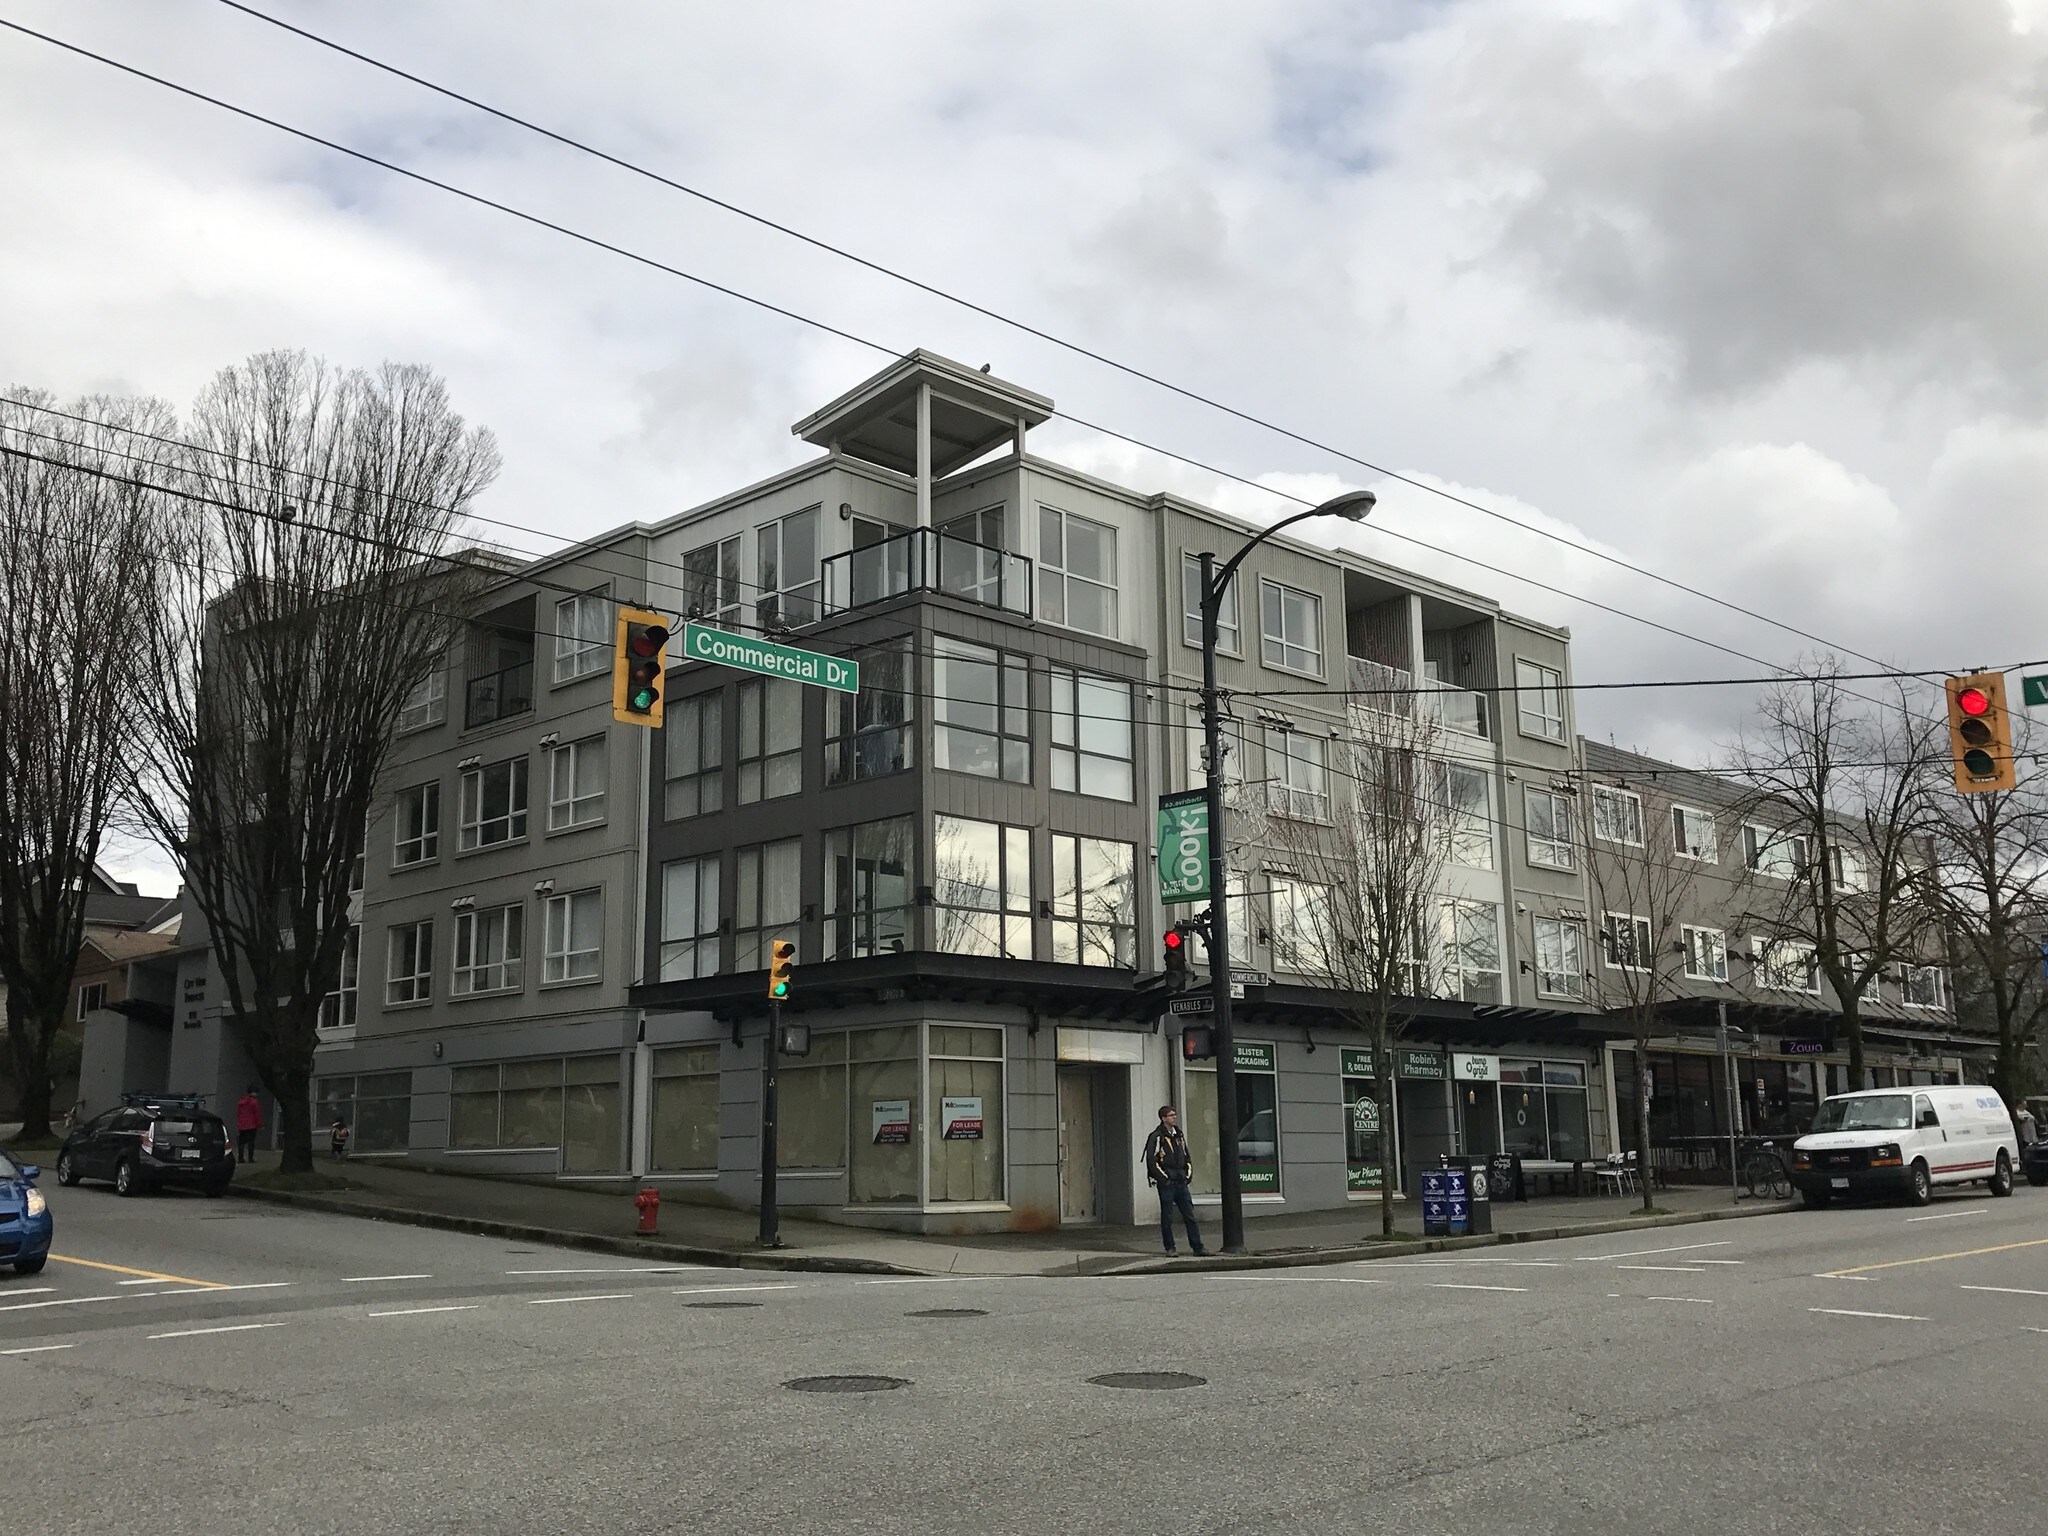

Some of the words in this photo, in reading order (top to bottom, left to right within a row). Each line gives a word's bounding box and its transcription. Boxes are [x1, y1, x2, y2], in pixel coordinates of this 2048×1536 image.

[696, 632, 818, 678] Commercial
[827, 661, 848, 685] Dr
[1231, 972, 1260, 983] COMMERCIAL
[1172, 1000, 1201, 1012] VENABLES
[1237, 1047, 1264, 1057] BLISTER
[1790, 1041, 1823, 1053] Zawa
[1233, 1057, 1269, 1066] PACKAGING
[1357, 1055, 1372, 1063] FREE
[1409, 1053, 1437, 1065] Robin's
[1354, 1062, 1373, 1072] DELIVE
[1404, 1063, 1443, 1078] Pharmacy
[952, 1121, 964, 1129] FOR
[1354, 1120, 1379, 1129] CENTRE
[1239, 1172, 1273, 1182] PHARMACY
[1347, 1169, 1361, 1181] Your
[1361, 1166, 1382, 1178] Pharm
